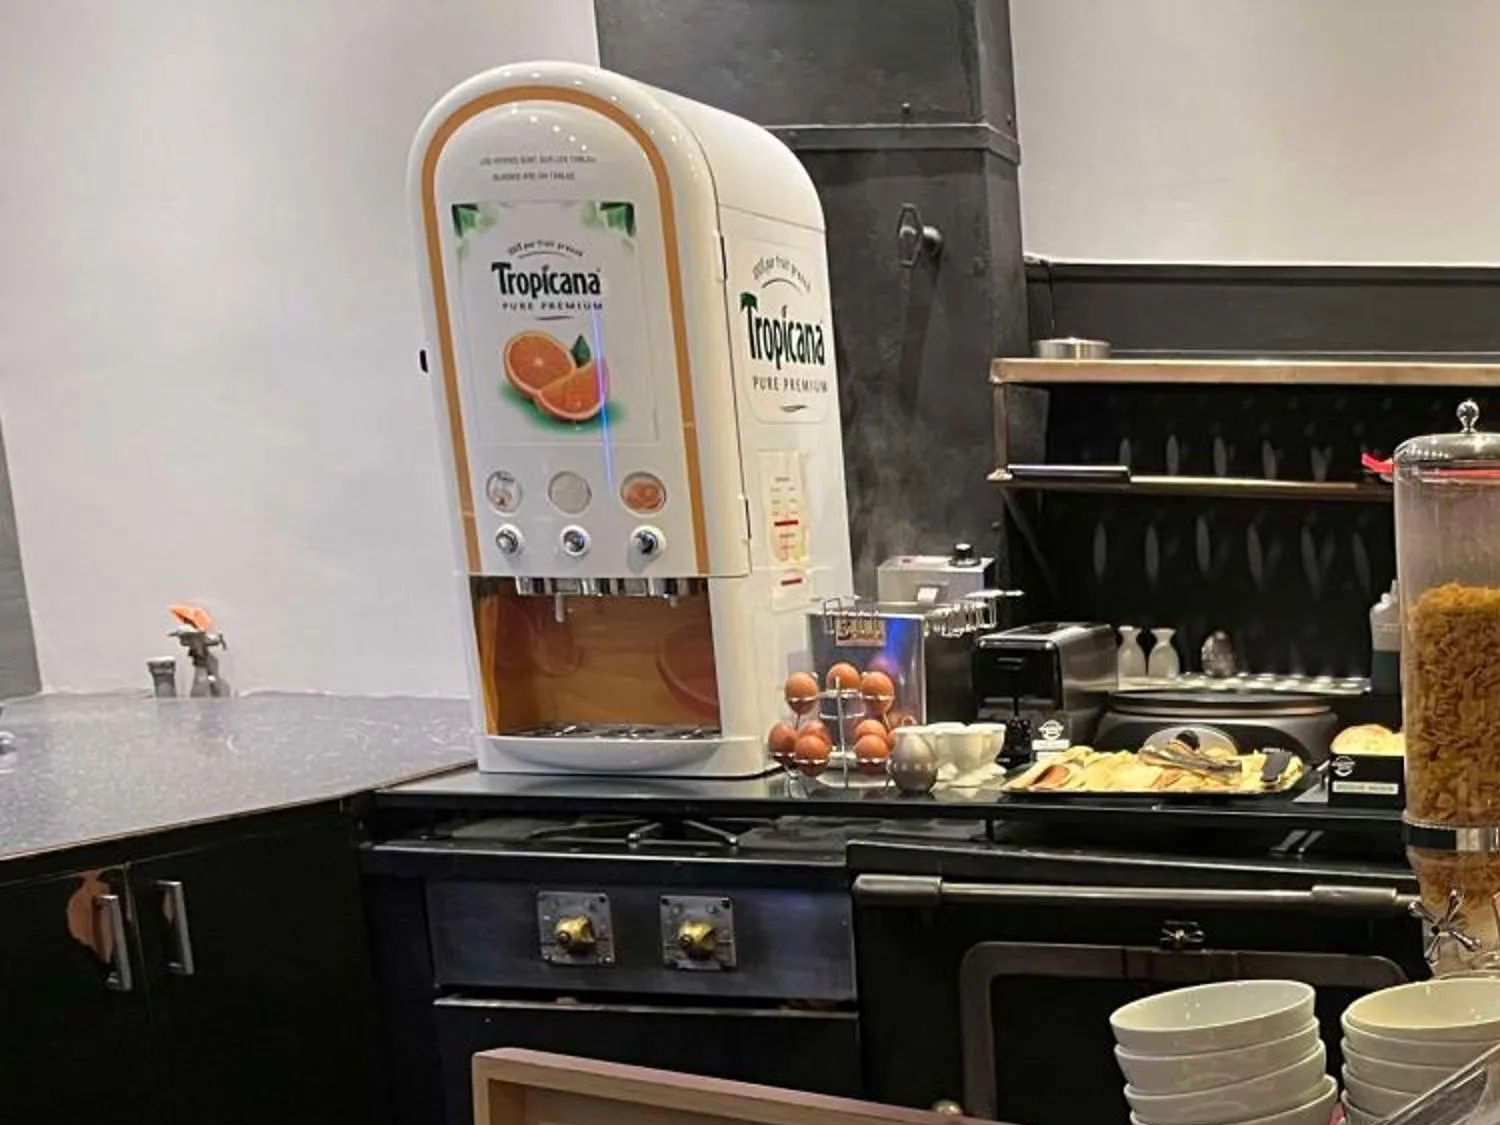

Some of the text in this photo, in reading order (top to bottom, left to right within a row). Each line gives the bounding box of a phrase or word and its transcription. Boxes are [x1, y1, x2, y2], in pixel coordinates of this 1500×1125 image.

[491, 261, 601, 299] Tropicana
[502, 301, 603, 310] PURE PREMIUM
[740, 291, 826, 370] Tropicana
[753, 375, 829, 393] PURE PREMIUM
